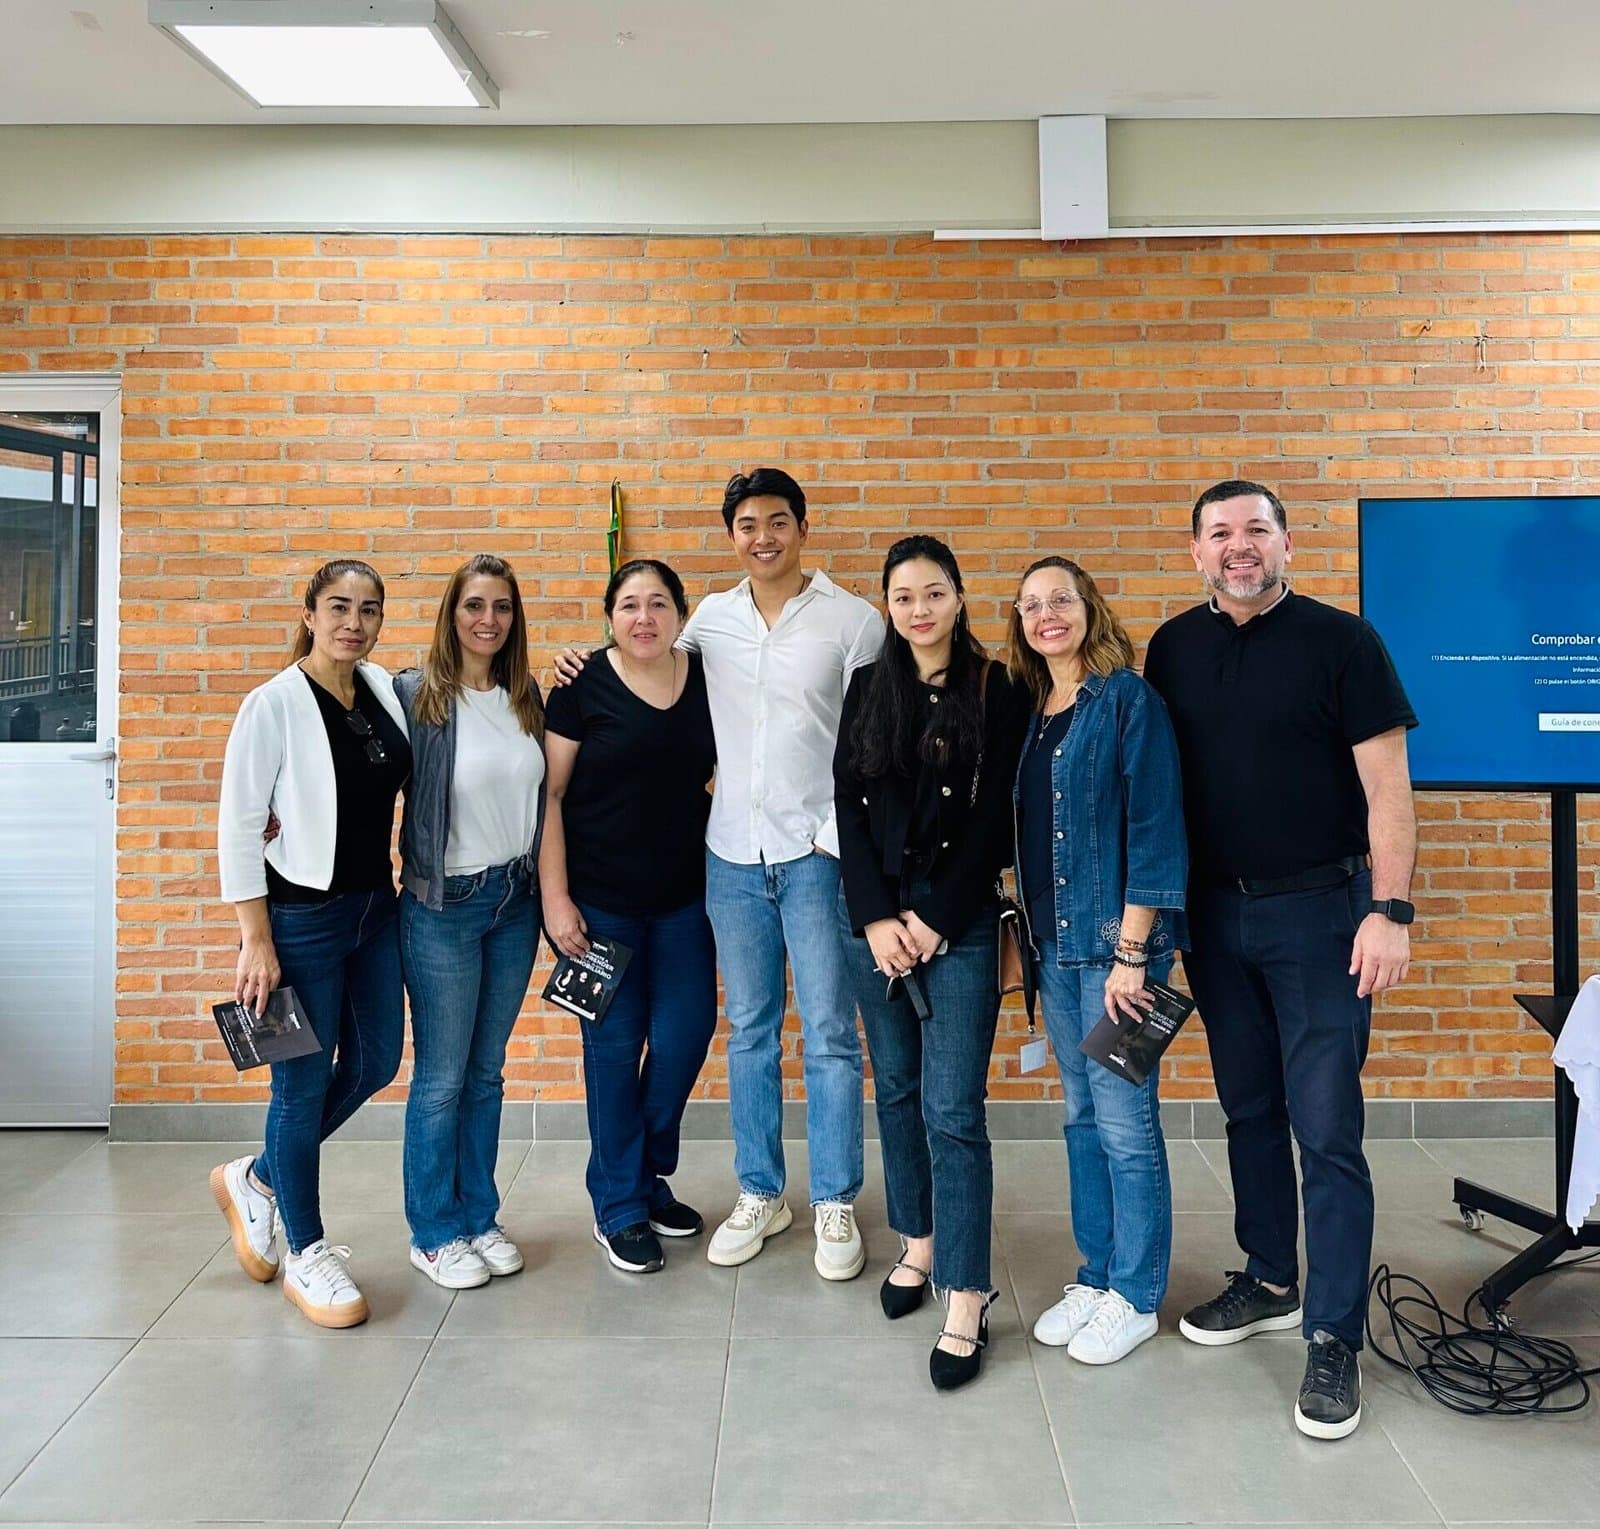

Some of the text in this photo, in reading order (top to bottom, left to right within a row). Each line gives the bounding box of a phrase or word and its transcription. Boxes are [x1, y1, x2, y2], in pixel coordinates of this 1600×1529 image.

[1531, 633, 1595, 647] Comprobar
[1551, 718, 1570, 726] Guía
[1571, 718, 1581, 726] de
